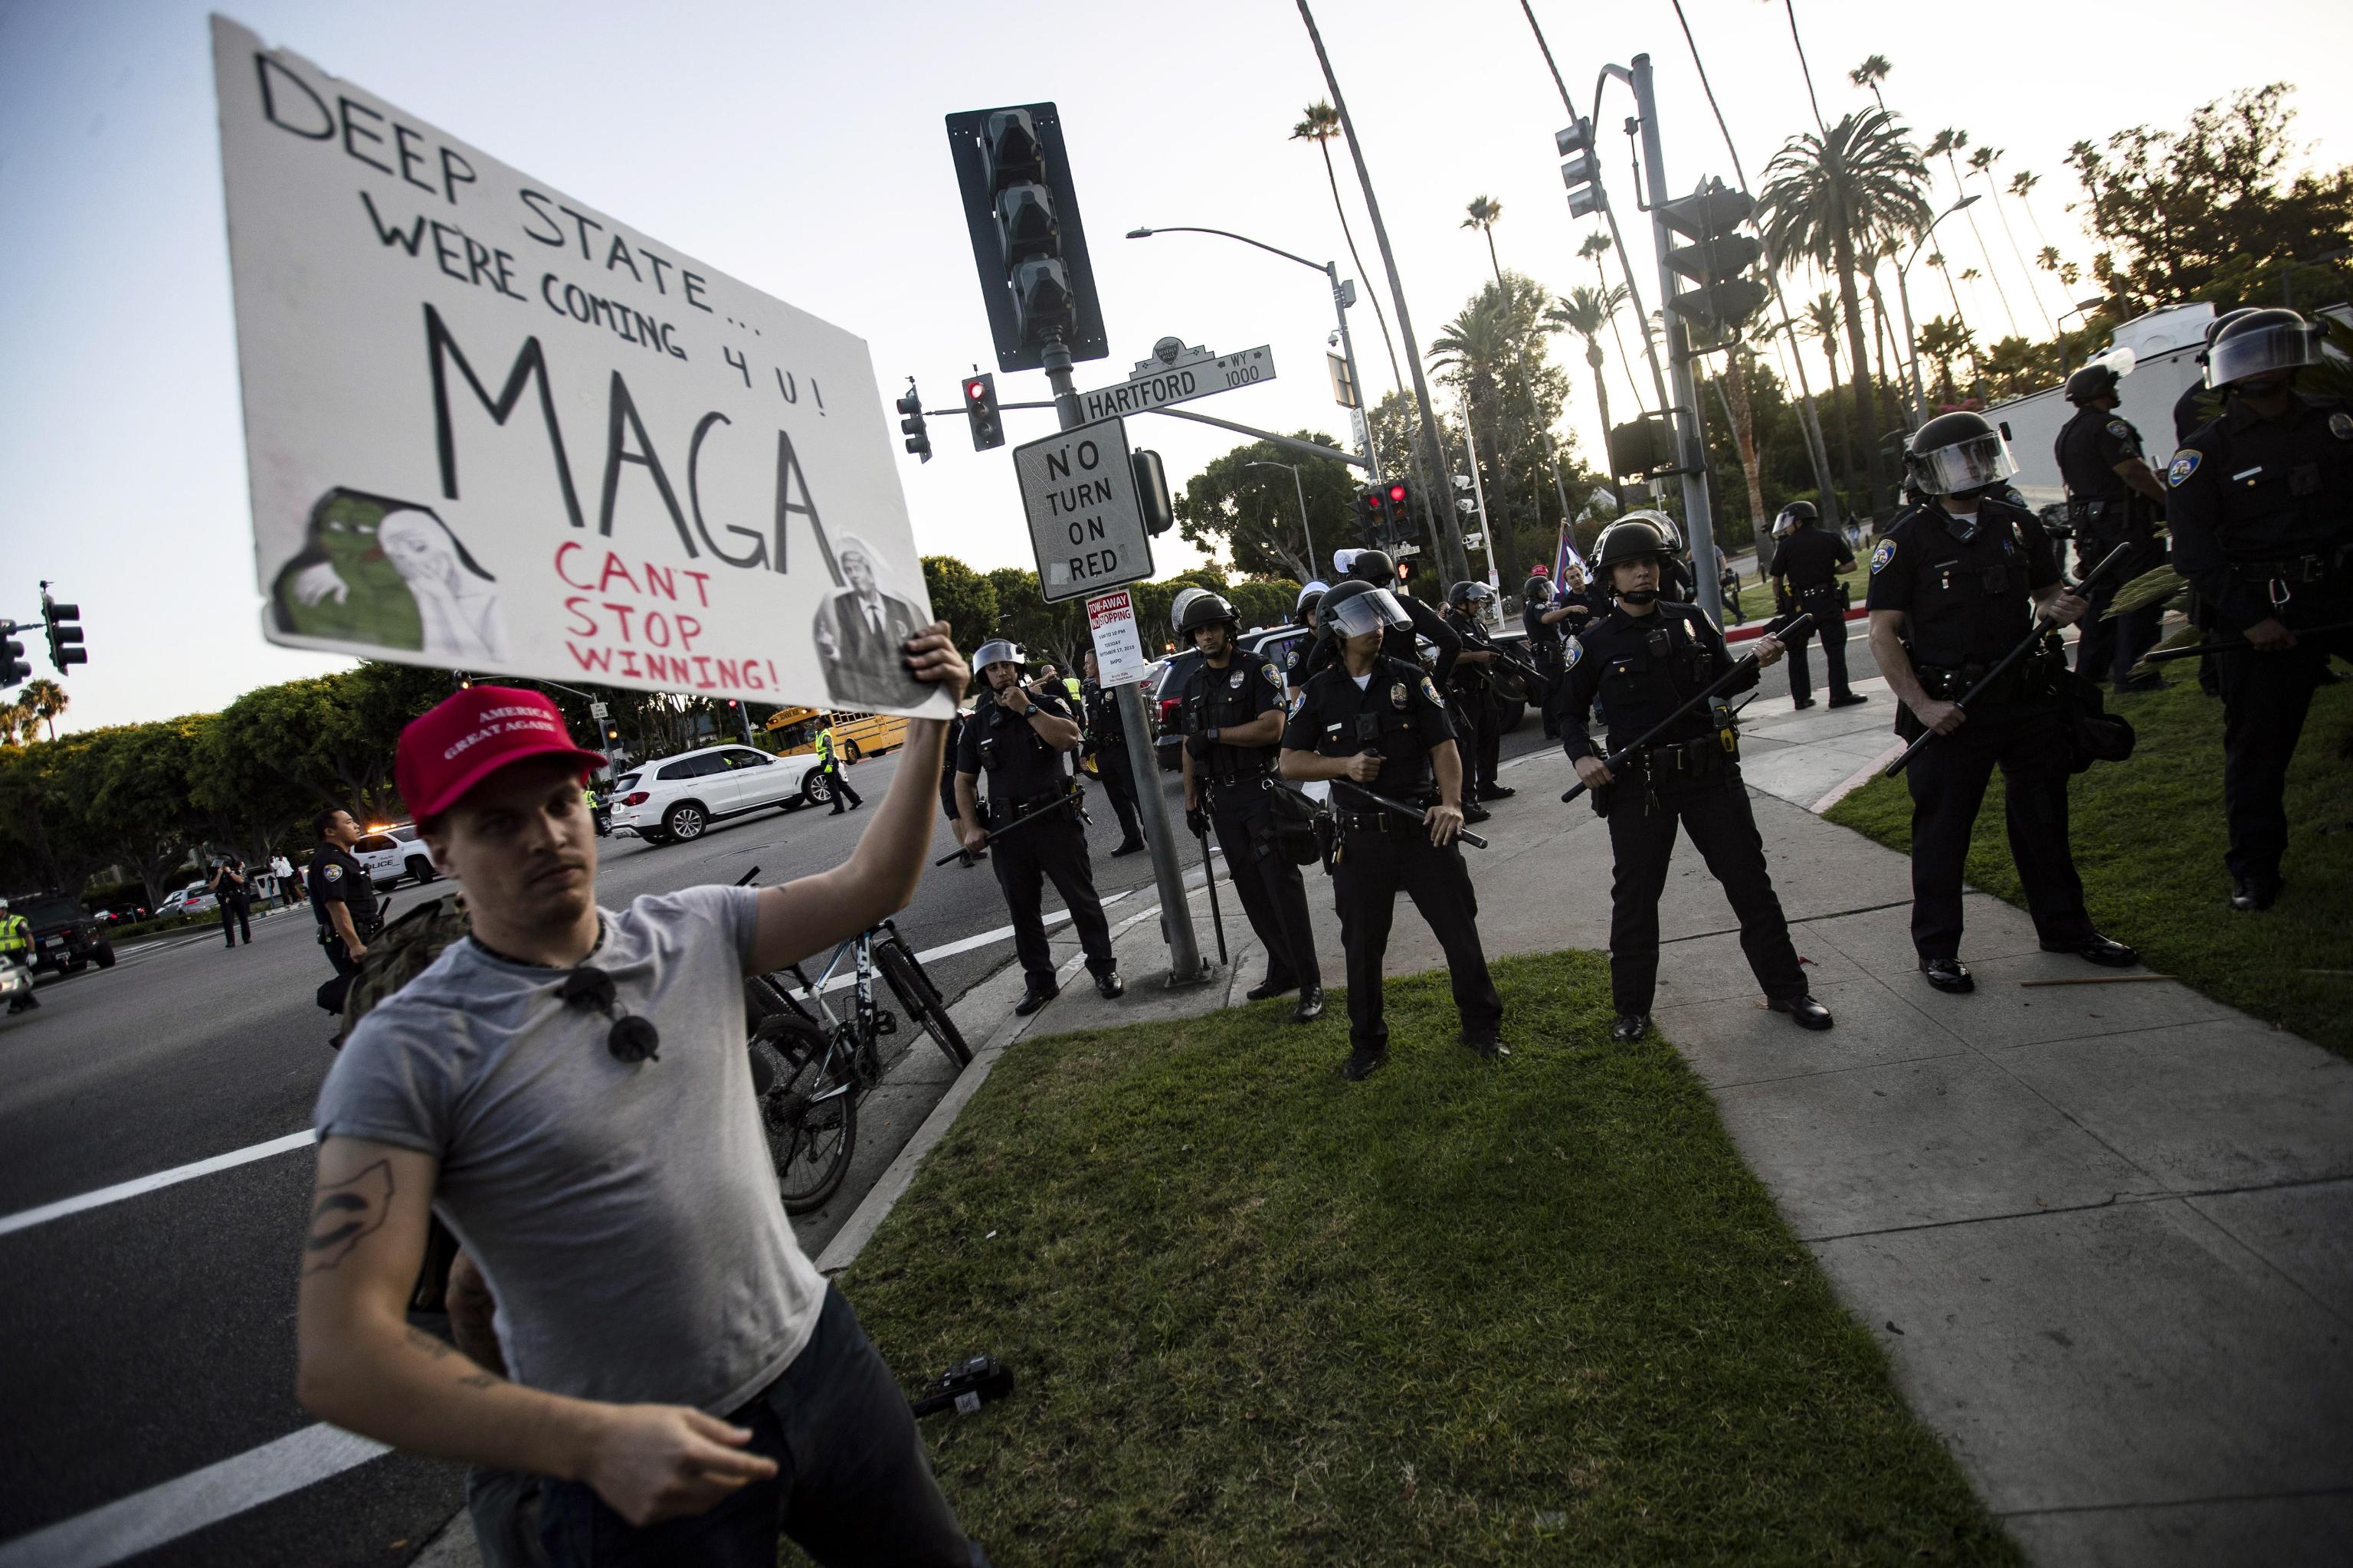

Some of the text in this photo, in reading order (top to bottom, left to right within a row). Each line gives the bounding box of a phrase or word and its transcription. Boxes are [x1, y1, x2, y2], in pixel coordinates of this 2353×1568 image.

[254, 52, 477, 205] DEEP
[541, 272, 689, 362] COMING
[723, 345, 752, 388] 4
[1158, 347, 1177, 355] BEVERLY
[1231, 352, 1247, 368] WY
[1226, 365, 1260, 388] 1000
[1087, 371, 1196, 420] HARTFORD
[421, 301, 847, 588] MAGA
[1046, 440, 1099, 481] NO
[1046, 477, 1113, 516] TURN
[1068, 516, 1106, 545] ON
[1069, 548, 1118, 581] RED
[1089, 594, 1127, 614] TOW-AWAY
[1092, 609, 1131, 629] NO STOPPING
[565, 596, 703, 652] STOP
[1099, 649, 1117, 657] SEPTEMBER
[1104, 640, 1121, 648] TUESDAY
[565, 640, 782, 692] WINNING!
[479, 705, 553, 723] AMERICA
[444, 723, 501, 760] GREAT
[370, 859, 394, 869] LICE
